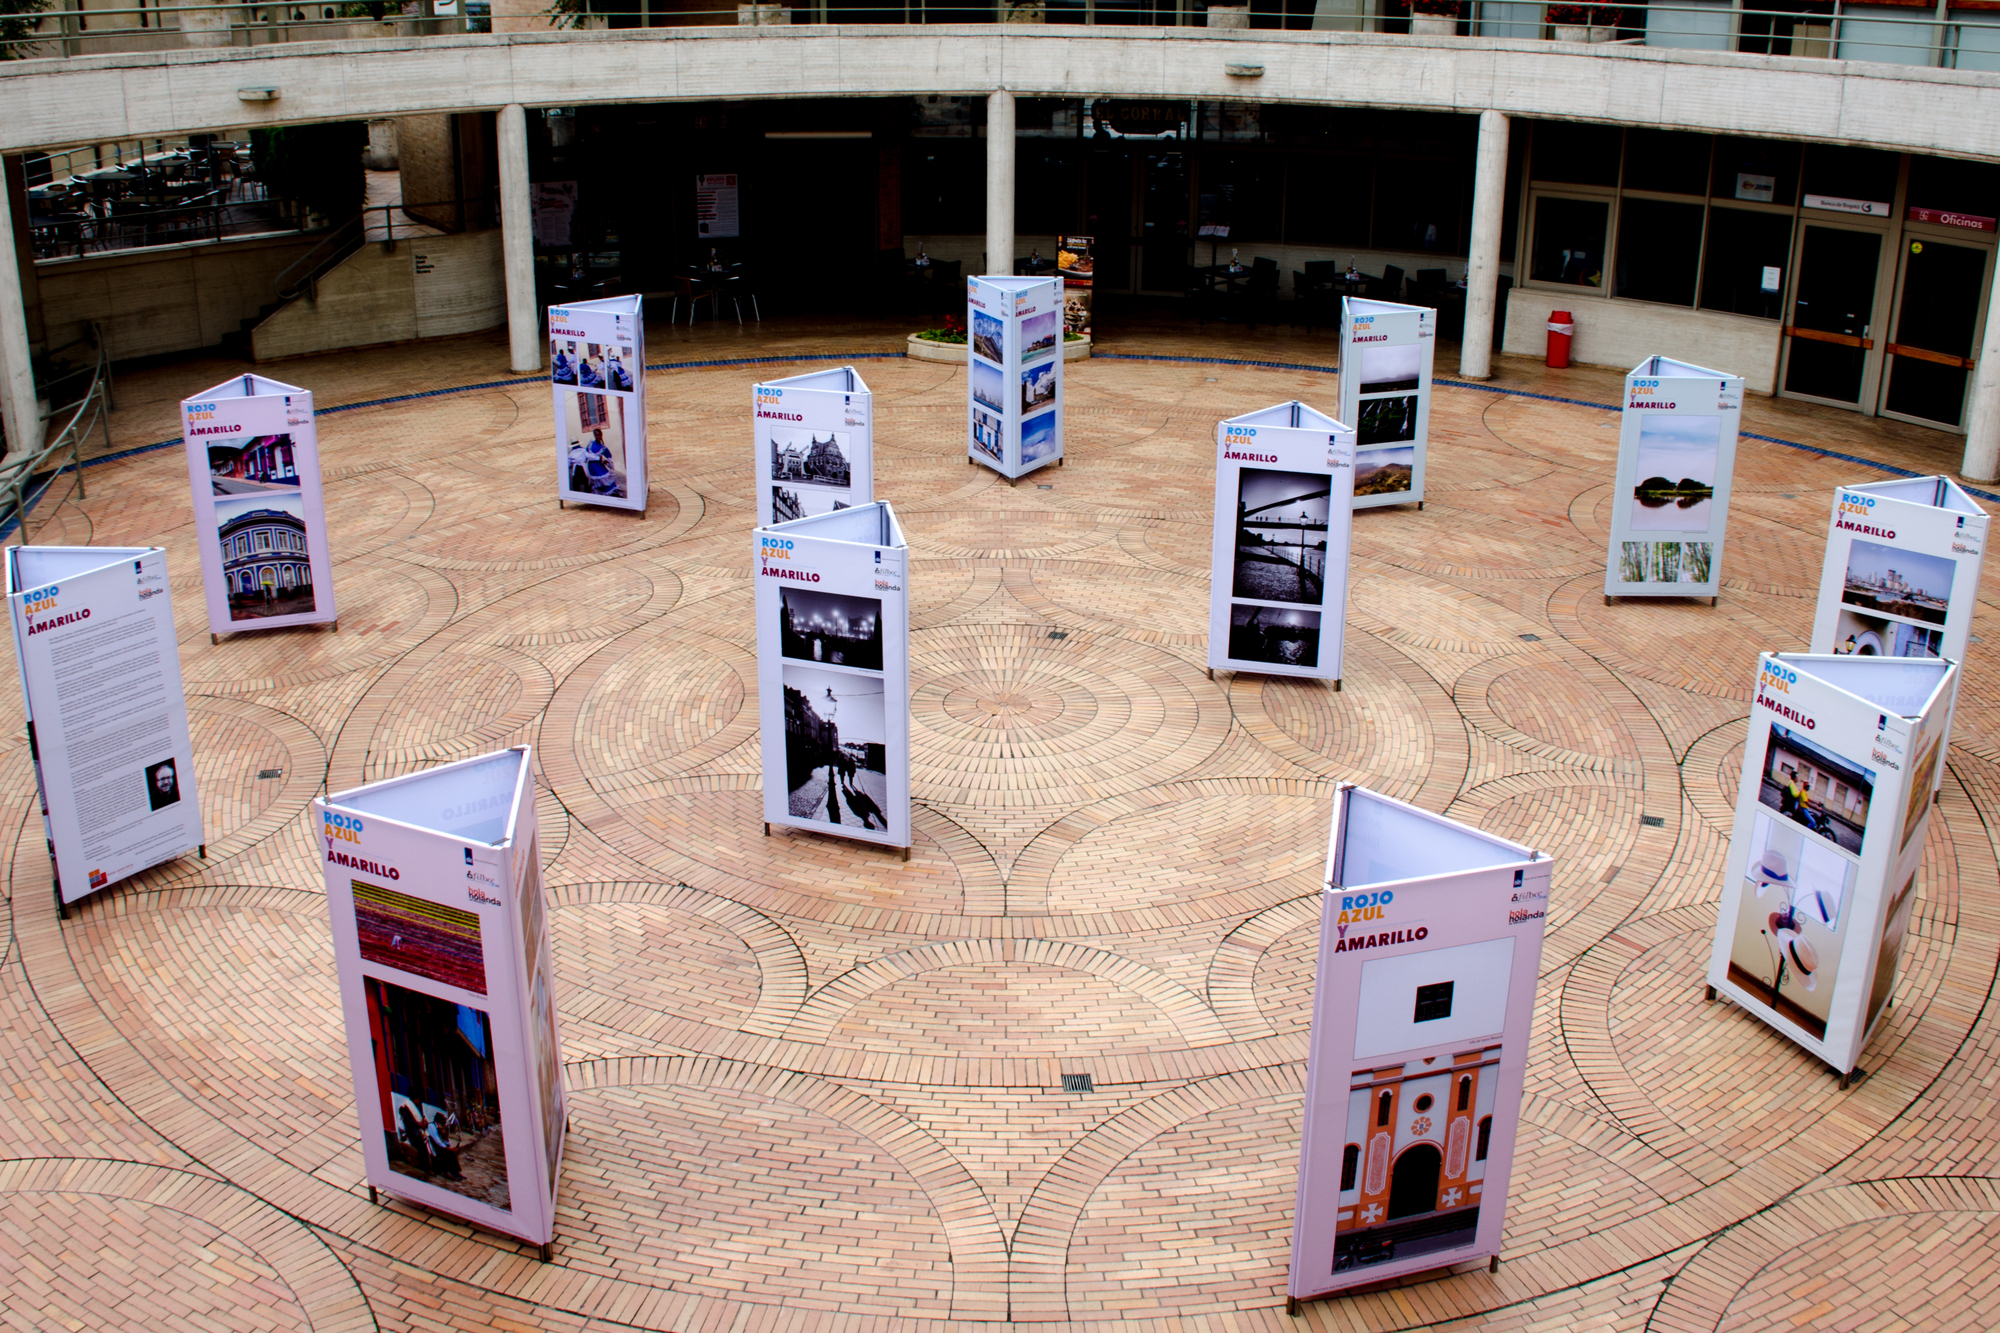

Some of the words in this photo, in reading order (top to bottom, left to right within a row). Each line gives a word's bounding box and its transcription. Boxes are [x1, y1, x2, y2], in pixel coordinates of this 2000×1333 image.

[1096, 107, 1114, 120] EL
[1120, 107, 1185, 121] CORRAL
[1941, 214, 1982, 228] Oficinas
[1016, 306, 1036, 317] AMARILLO
[551, 328, 585, 337] AMARILLO
[1352, 335, 1388, 343] AMARILLO
[758, 388, 782, 396] ROJO
[757, 396, 780, 404] AZUL
[188, 404, 216, 412] ROJO
[188, 412, 214, 420] AZUL
[757, 411, 803, 421] AMARILLO
[190, 424, 242, 436] AMARILLO
[1227, 427, 1256, 436] ROJO
[1225, 435, 1252, 444] AZUL
[1224, 452, 1278, 462] AMARILLO
[1842, 494, 1875, 507] ROJO
[1839, 503, 1868, 516] AZUL
[1836, 520, 1896, 539] AMARILLO
[762, 538, 794, 550] ROJO
[1952, 546, 1978, 555] holanda
[761, 548, 790, 559] AZUL
[761, 557, 768, 566] Y
[762, 567, 820, 582] AMARILLO
[24, 586, 59, 604] ROJO
[139, 588, 163, 600] holanda
[25, 598, 57, 614] AZUL
[27, 614, 34, 624] Y
[28, 608, 91, 636] AMARILLO
[1765, 660, 1797, 684] ROJO
[1760, 672, 1789, 694] AZUL
[1760, 682, 1768, 694] Y
[1757, 694, 1816, 730] AMARILLO
[1872, 753, 1899, 770] holanda
[324, 811, 363, 832] ROJO
[325, 824, 361, 844] AZUL
[326, 837, 334, 849] Y
[327, 850, 400, 880] AMARILLO
[468, 892, 501, 906] holanda
[1342, 891, 1393, 910] ROJO
[1337, 906, 1384, 925] AZUL
[1509, 910, 1544, 923] holanda
[1337, 925, 1349, 938] Y
[1335, 927, 1428, 953] AMARILLO
